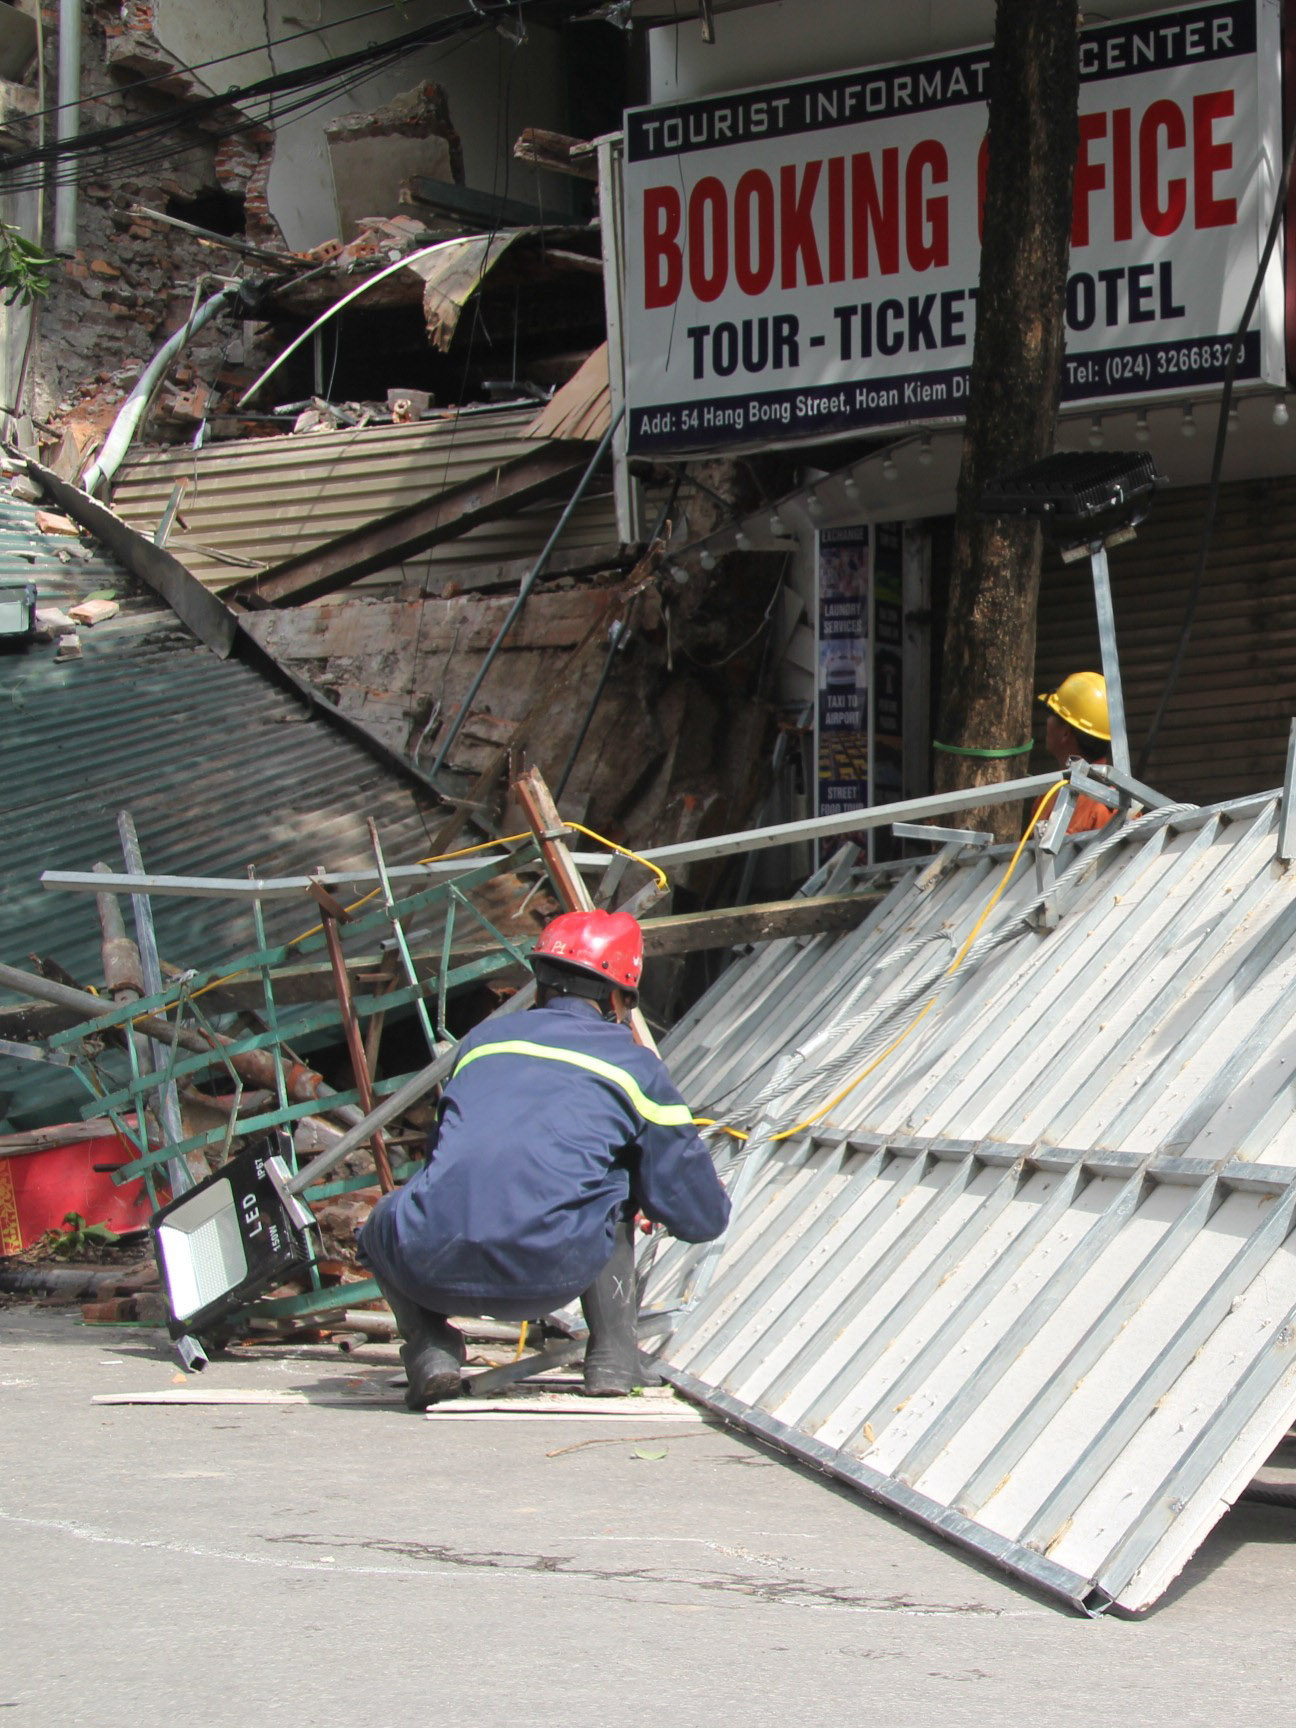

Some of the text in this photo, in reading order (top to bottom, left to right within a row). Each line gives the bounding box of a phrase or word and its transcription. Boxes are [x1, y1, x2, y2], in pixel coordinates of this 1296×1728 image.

[643, 16, 1235, 152] TOURIST INFORMAT CENTER
[643, 89, 1238, 310] BOOKING FICE
[687, 314, 799, 379] TOUR
[1066, 261, 1185, 332] OTEL
[1067, 362, 1099, 384] Tel:
[1105, 353, 1151, 385] (024)
[641, 414, 676, 435] Add:
[681, 410, 699, 429] 54
[704, 405, 743, 429] Hang
[749, 400, 791, 424] Bong
[796, 393, 850, 417] Street,
[856, 387, 898, 410] Hoan
[905, 381, 946, 404] Kiem
[824, 603, 861, 617] LAUNDRY
[823, 620, 862, 634] SERVICES
[827, 694, 845, 708] TAXI
[825, 711, 860, 725] AIRPORT
[827, 787, 857, 800] STREET
[254, 1158, 266, 1181] IP67
[242, 1193, 263, 1238] LED
[268, 1225, 282, 1252] 150W
